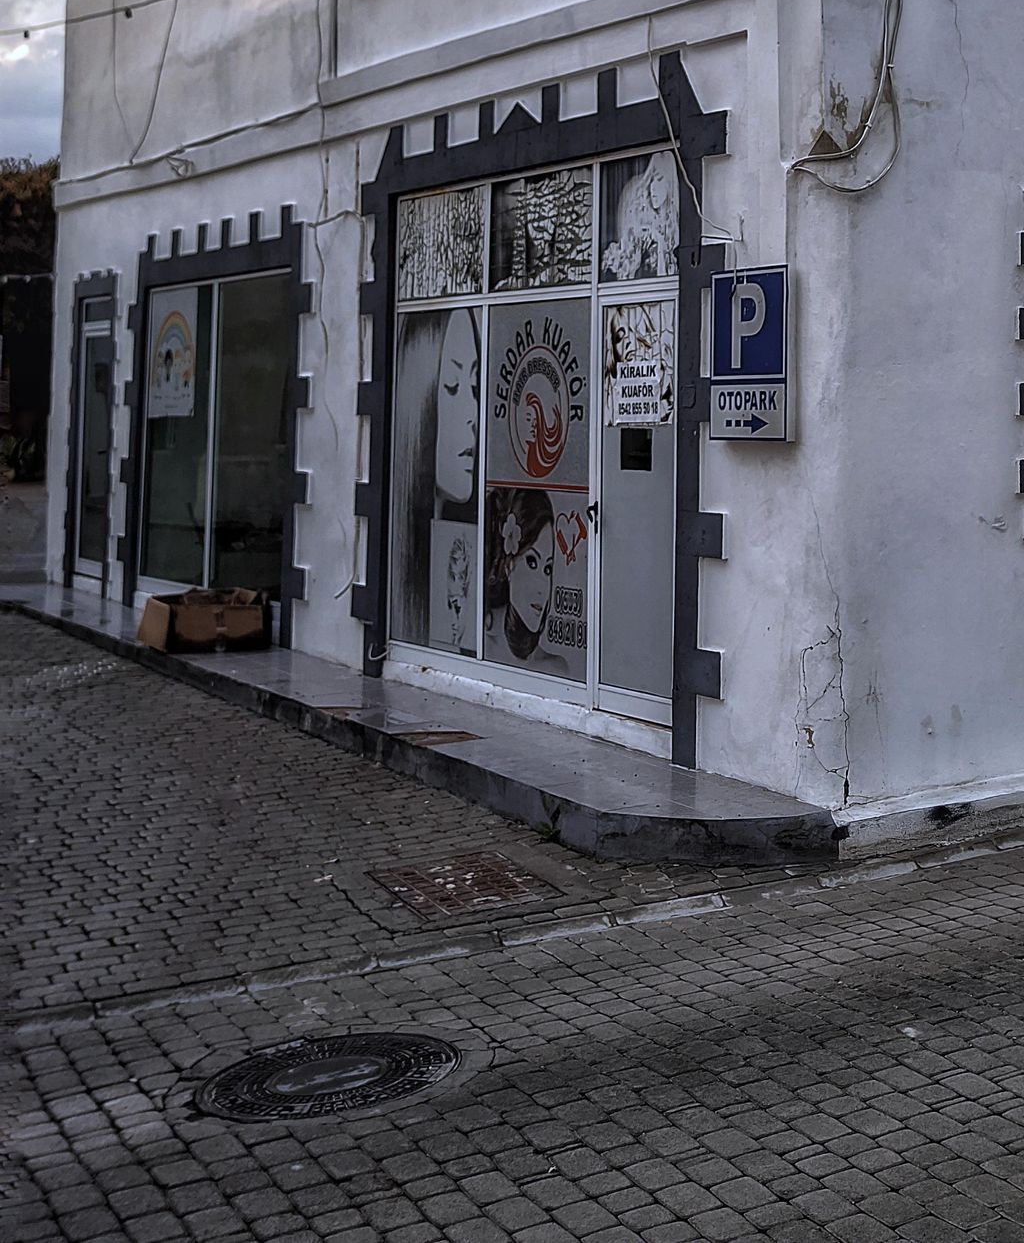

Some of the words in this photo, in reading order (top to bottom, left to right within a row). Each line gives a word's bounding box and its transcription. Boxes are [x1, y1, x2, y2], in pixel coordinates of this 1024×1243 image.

[731, 282, 766, 369] P
[494, 319, 535, 419] SERDAR
[542, 316, 586, 422] KUAFÖR
[526, 356, 560, 394] DRESSER
[620, 363, 657, 379] KİRALIK
[621, 381, 655, 398] KUAFÖR
[718, 390, 777, 411] OTOPARK
